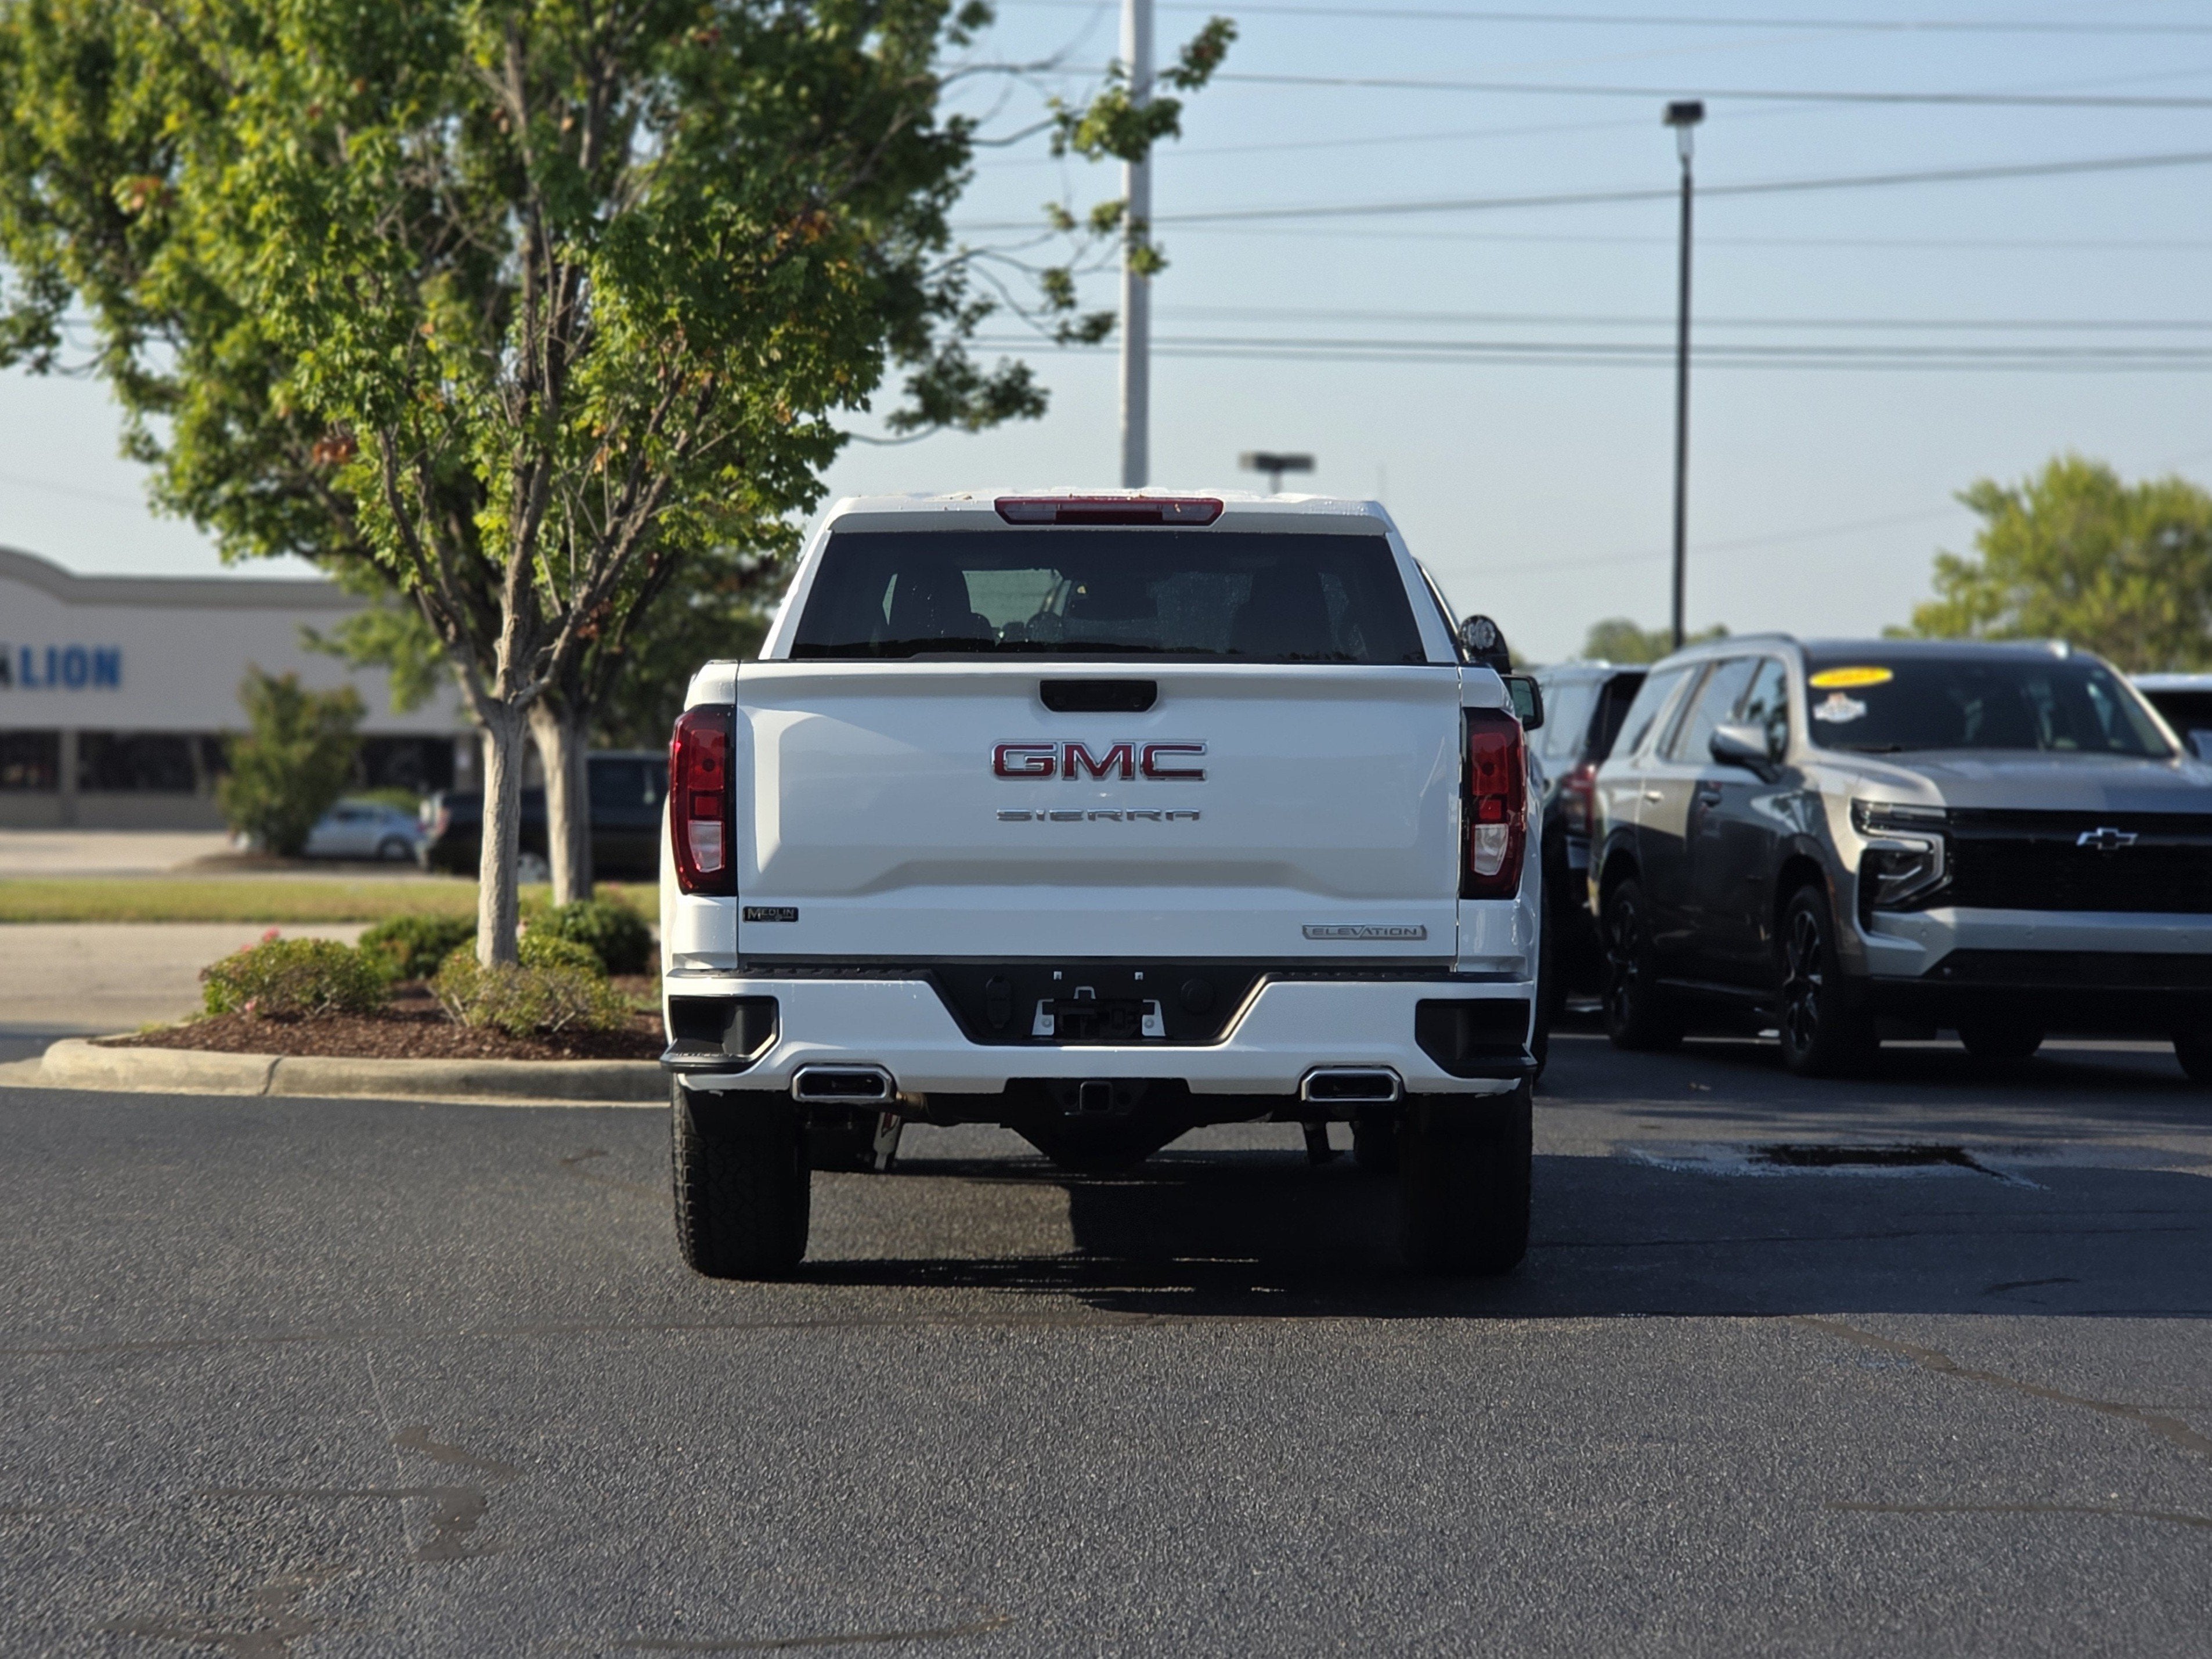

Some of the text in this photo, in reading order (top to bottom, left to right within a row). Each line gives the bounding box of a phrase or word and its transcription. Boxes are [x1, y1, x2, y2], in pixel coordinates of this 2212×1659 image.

[20, 644, 120, 689] LION
[991, 742, 1207, 780] GMC
[996, 809, 1200, 822] SIERRA
